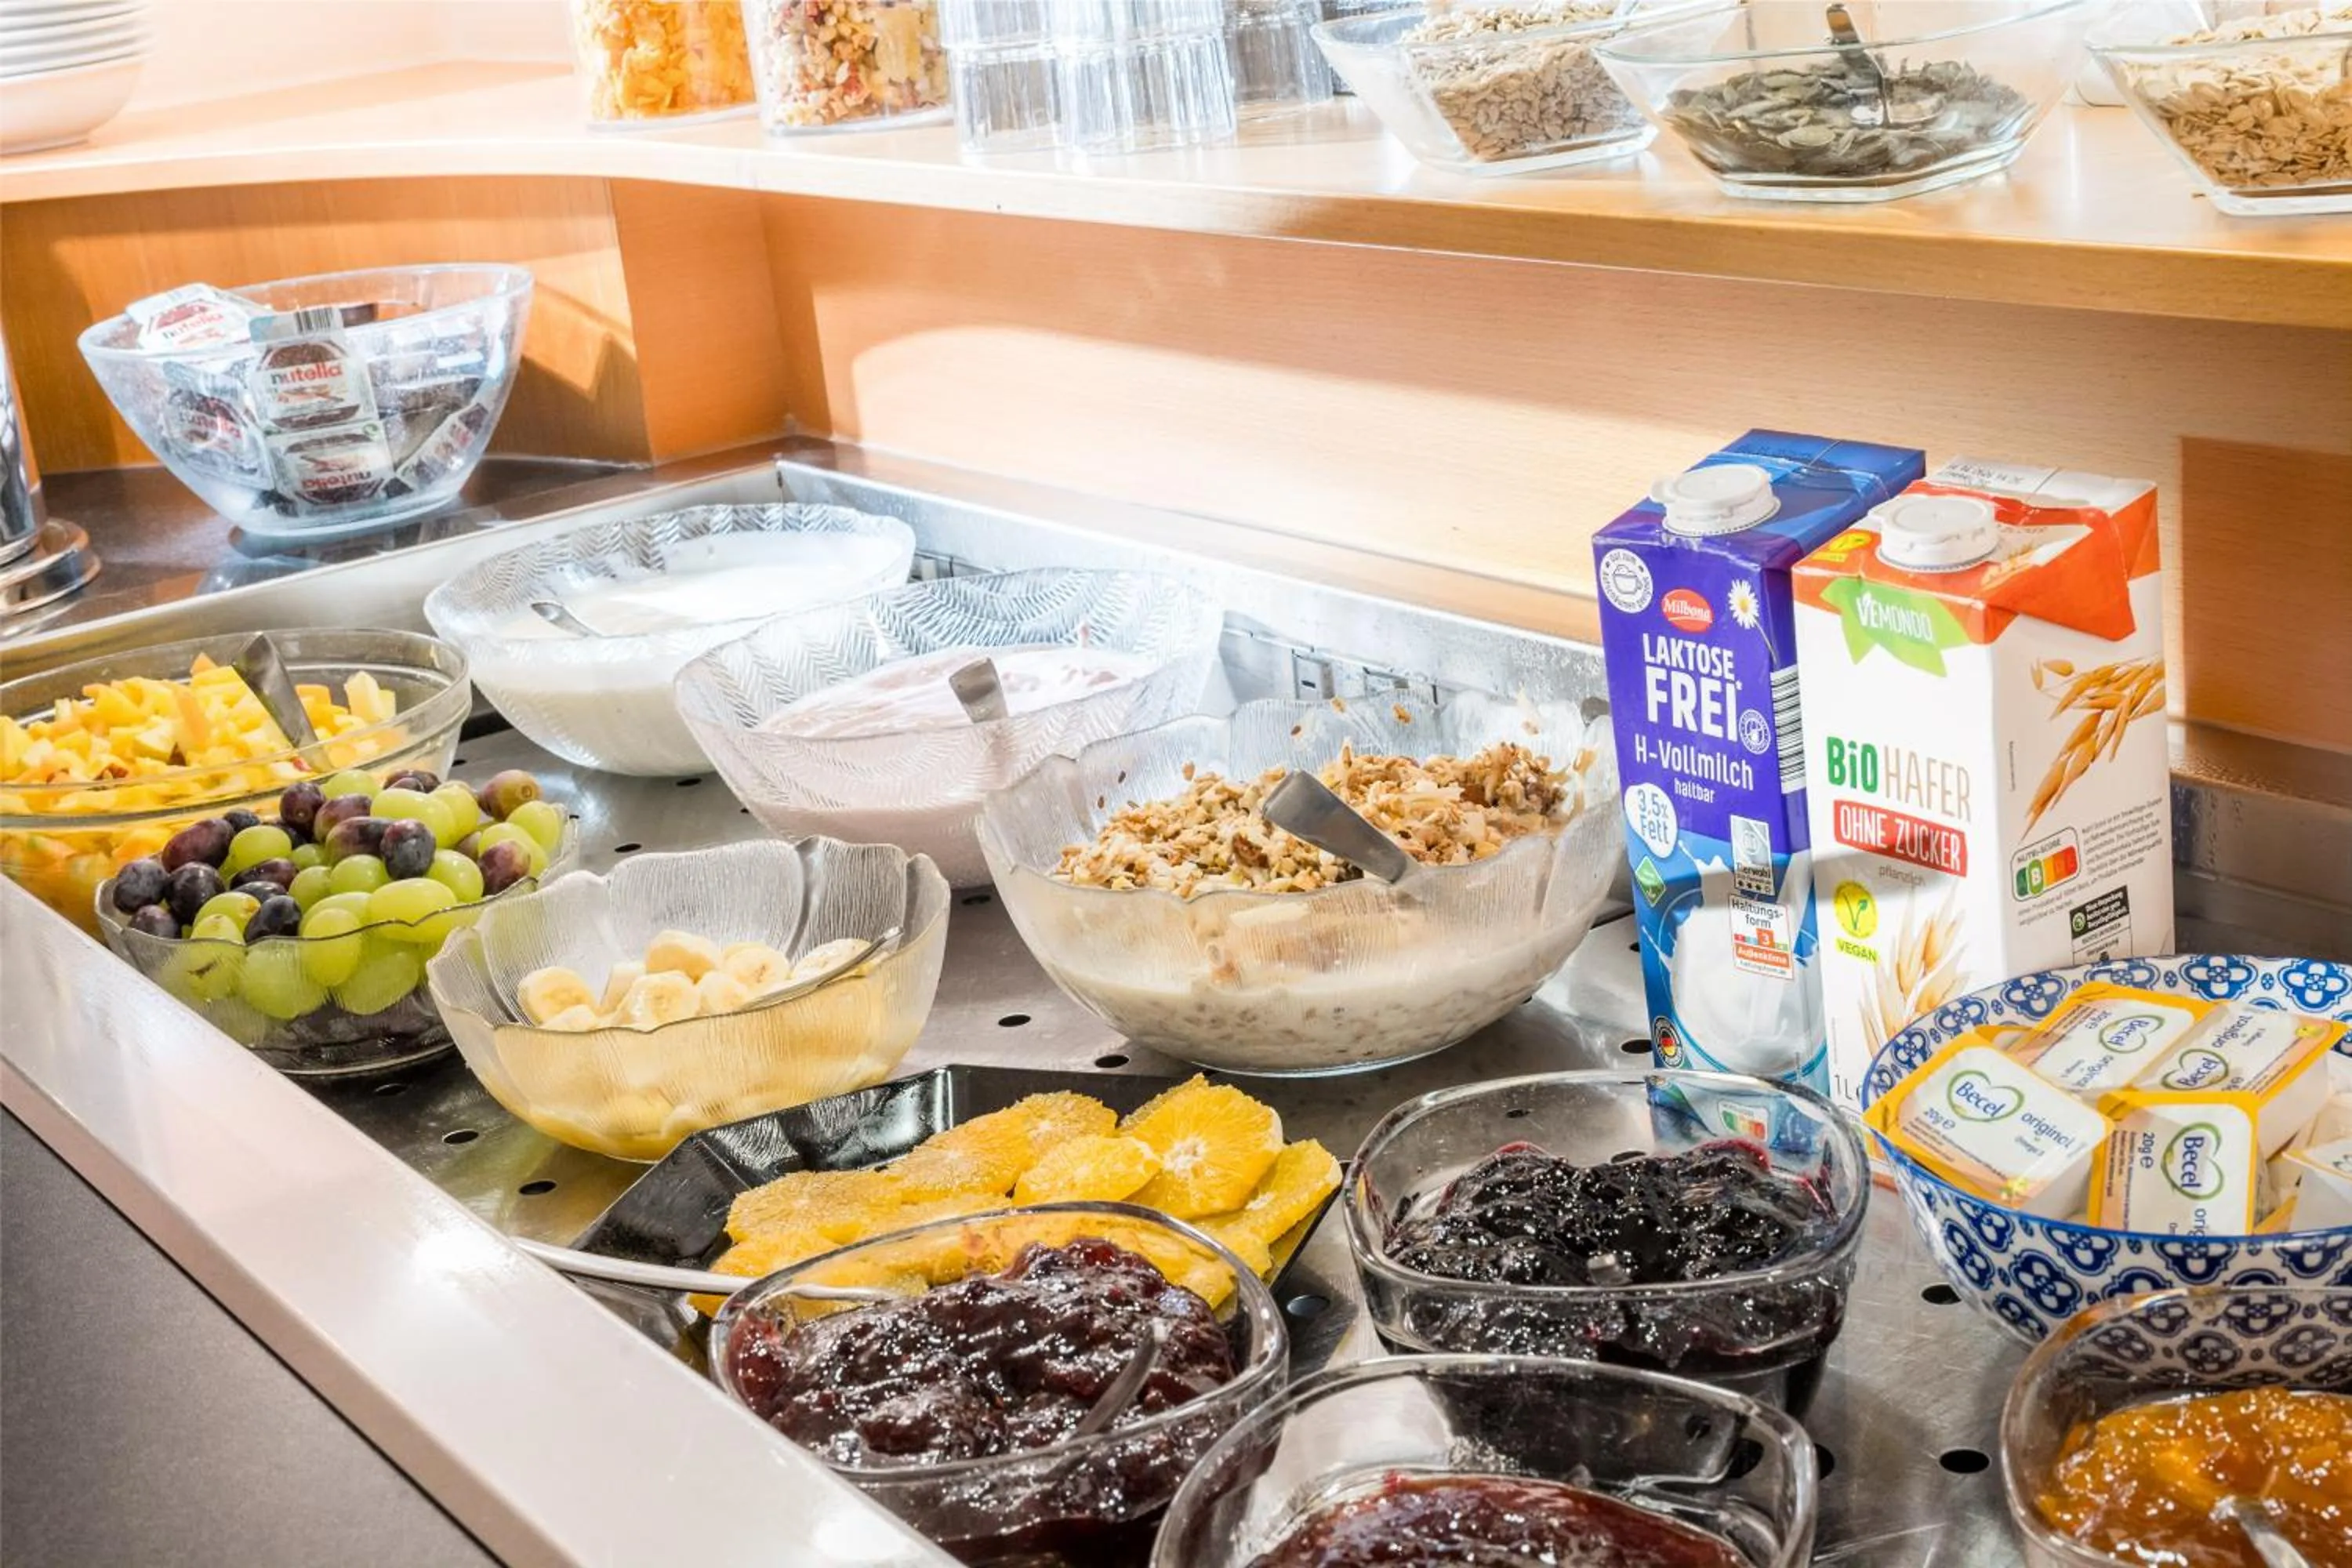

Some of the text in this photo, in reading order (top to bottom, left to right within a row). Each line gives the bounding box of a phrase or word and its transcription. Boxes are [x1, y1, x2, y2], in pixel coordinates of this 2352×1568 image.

[270, 362, 343, 384] nutella
[302, 471, 372, 489] nutella
[1663, 596, 1711, 619] Milbona
[1856, 591, 1933, 641] VEMONDO
[1642, 633, 1735, 681] LAKTOSE
[1635, 734, 1754, 791] H-Vollmilch
[1674, 777, 1715, 804] haltbar
[1884, 745, 1972, 822] HAFER
[1639, 815, 1670, 845] Fett
[1840, 806, 1962, 872] OHNE ZUCKER
[1732, 898, 1784, 920] Haltungs-
[1745, 913, 1772, 929] form
[1836, 938, 1878, 963] VEGAN
[2107, 1019, 2150, 1047] Becel
[2211, 1014, 2254, 1049] original
[2177, 1056, 2220, 1087] Becel
[1955, 1080, 2007, 1118] Becel
[2020, 1112, 2075, 1149] original
[2138, 1132, 2155, 1154] 20g
[2180, 1136, 2205, 1189] Becel
